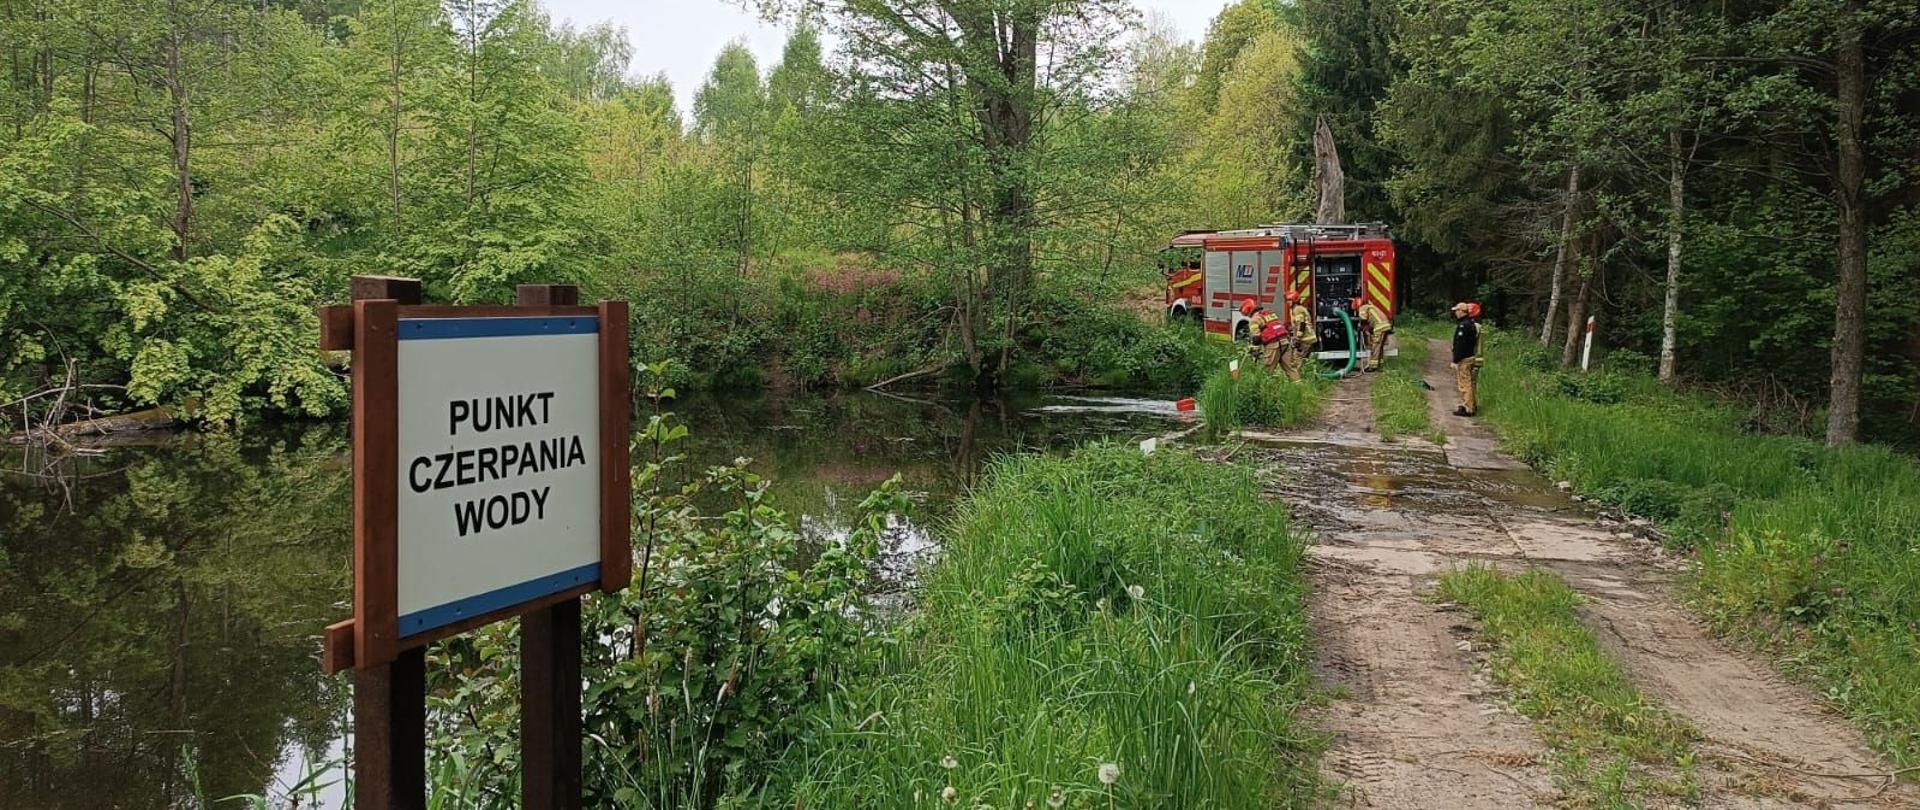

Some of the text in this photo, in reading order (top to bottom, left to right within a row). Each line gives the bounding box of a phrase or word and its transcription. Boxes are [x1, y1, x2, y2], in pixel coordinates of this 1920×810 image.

[449, 391, 554, 436] PUNKT
[408, 435, 586, 493] CZERPANIA
[454, 486, 551, 537] WODY
